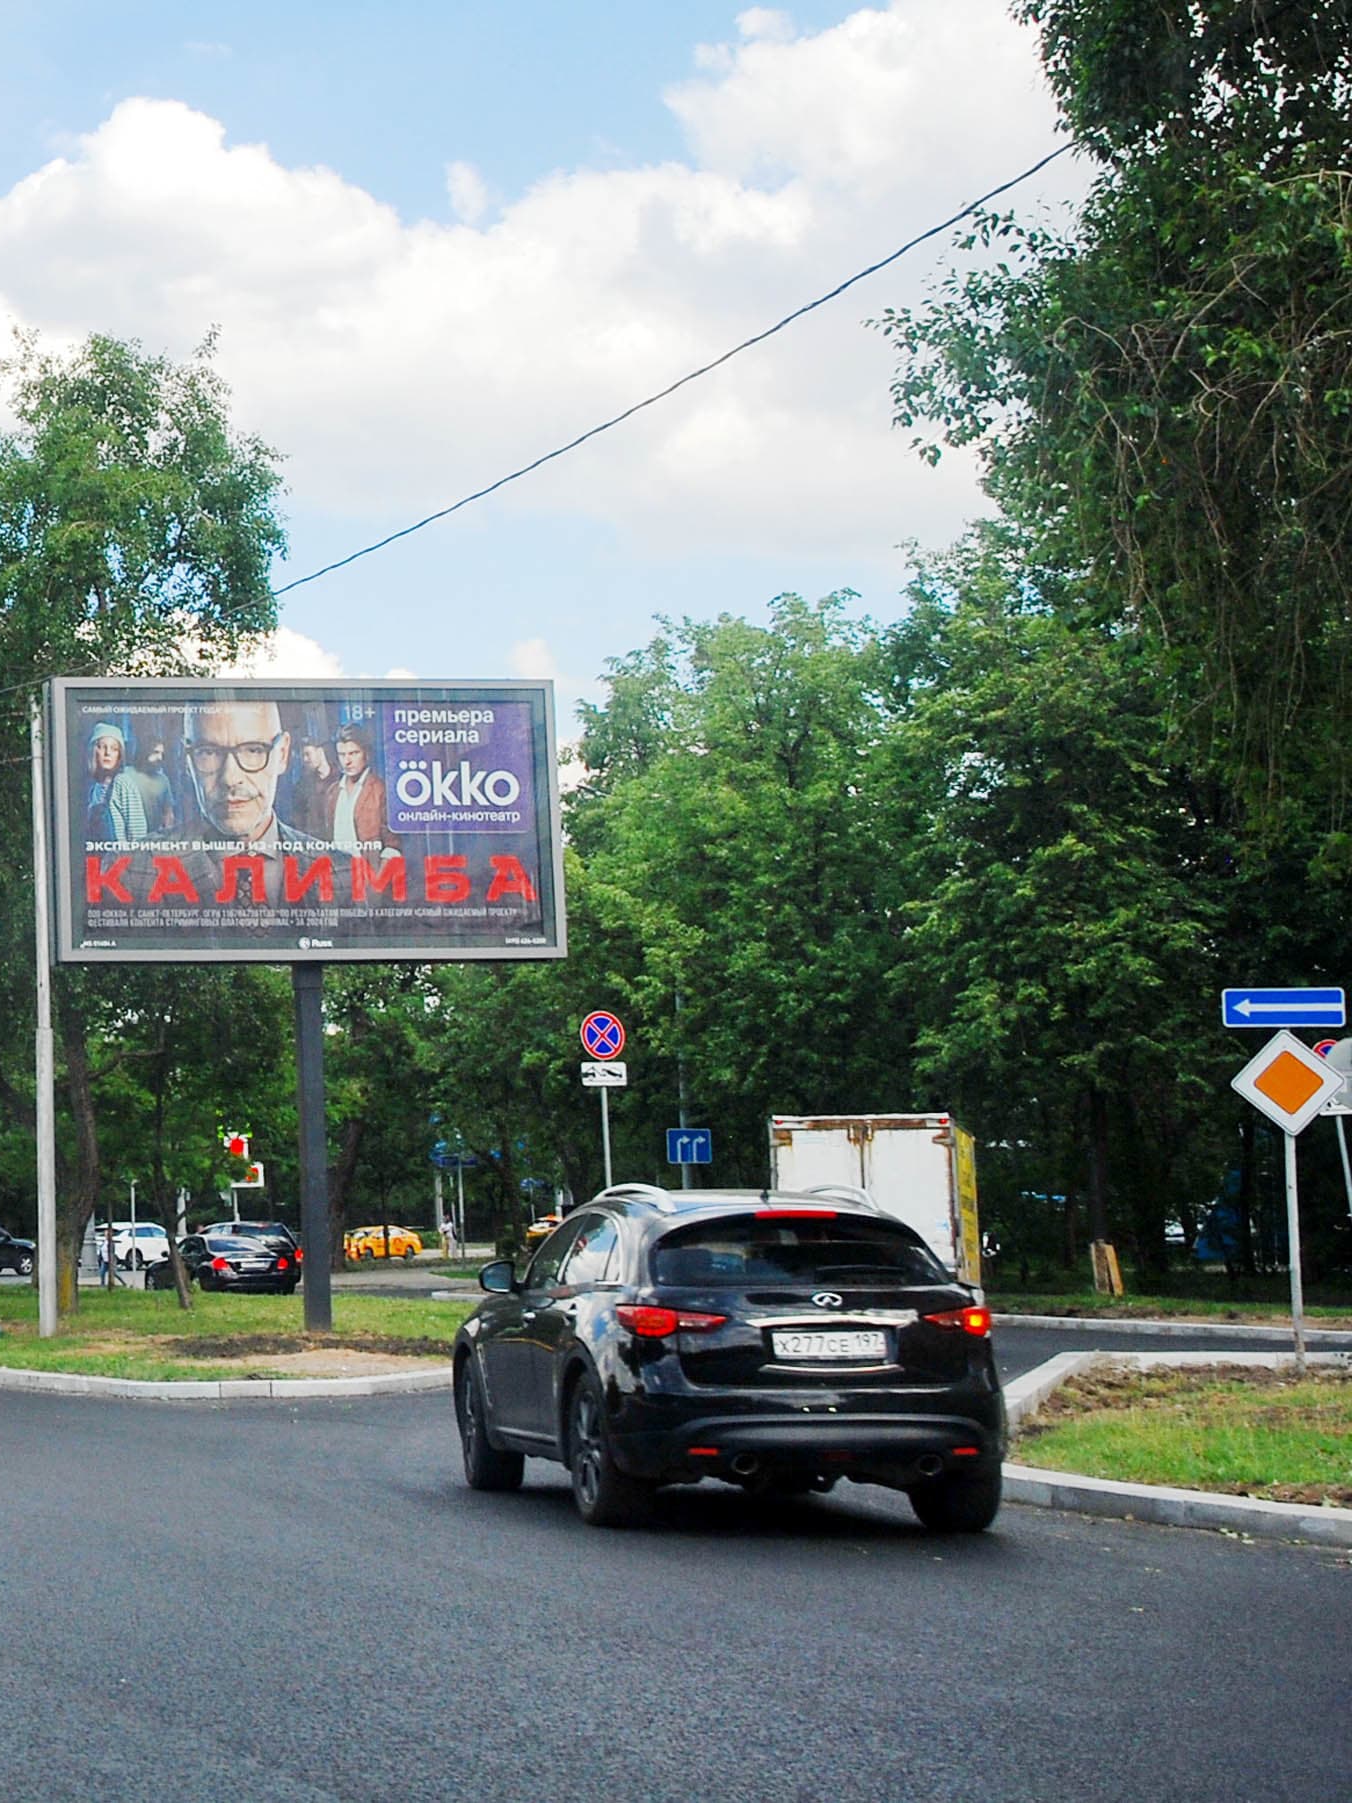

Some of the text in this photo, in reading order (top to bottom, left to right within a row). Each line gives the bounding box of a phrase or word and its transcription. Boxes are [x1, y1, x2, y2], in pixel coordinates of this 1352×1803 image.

[345, 705, 376, 720] 18+
[394, 709, 494, 726] премьера
[394, 729, 479, 746] сериала
[398, 808, 521, 822] онлайн-кинотеатр
[85, 840, 382, 852] ЭКСПЕРИМЕНТ ВЫШЕЛ ИЗ-ПОД КОНТРОЛЯ
[85, 854, 538, 903] КАЛИМБА
